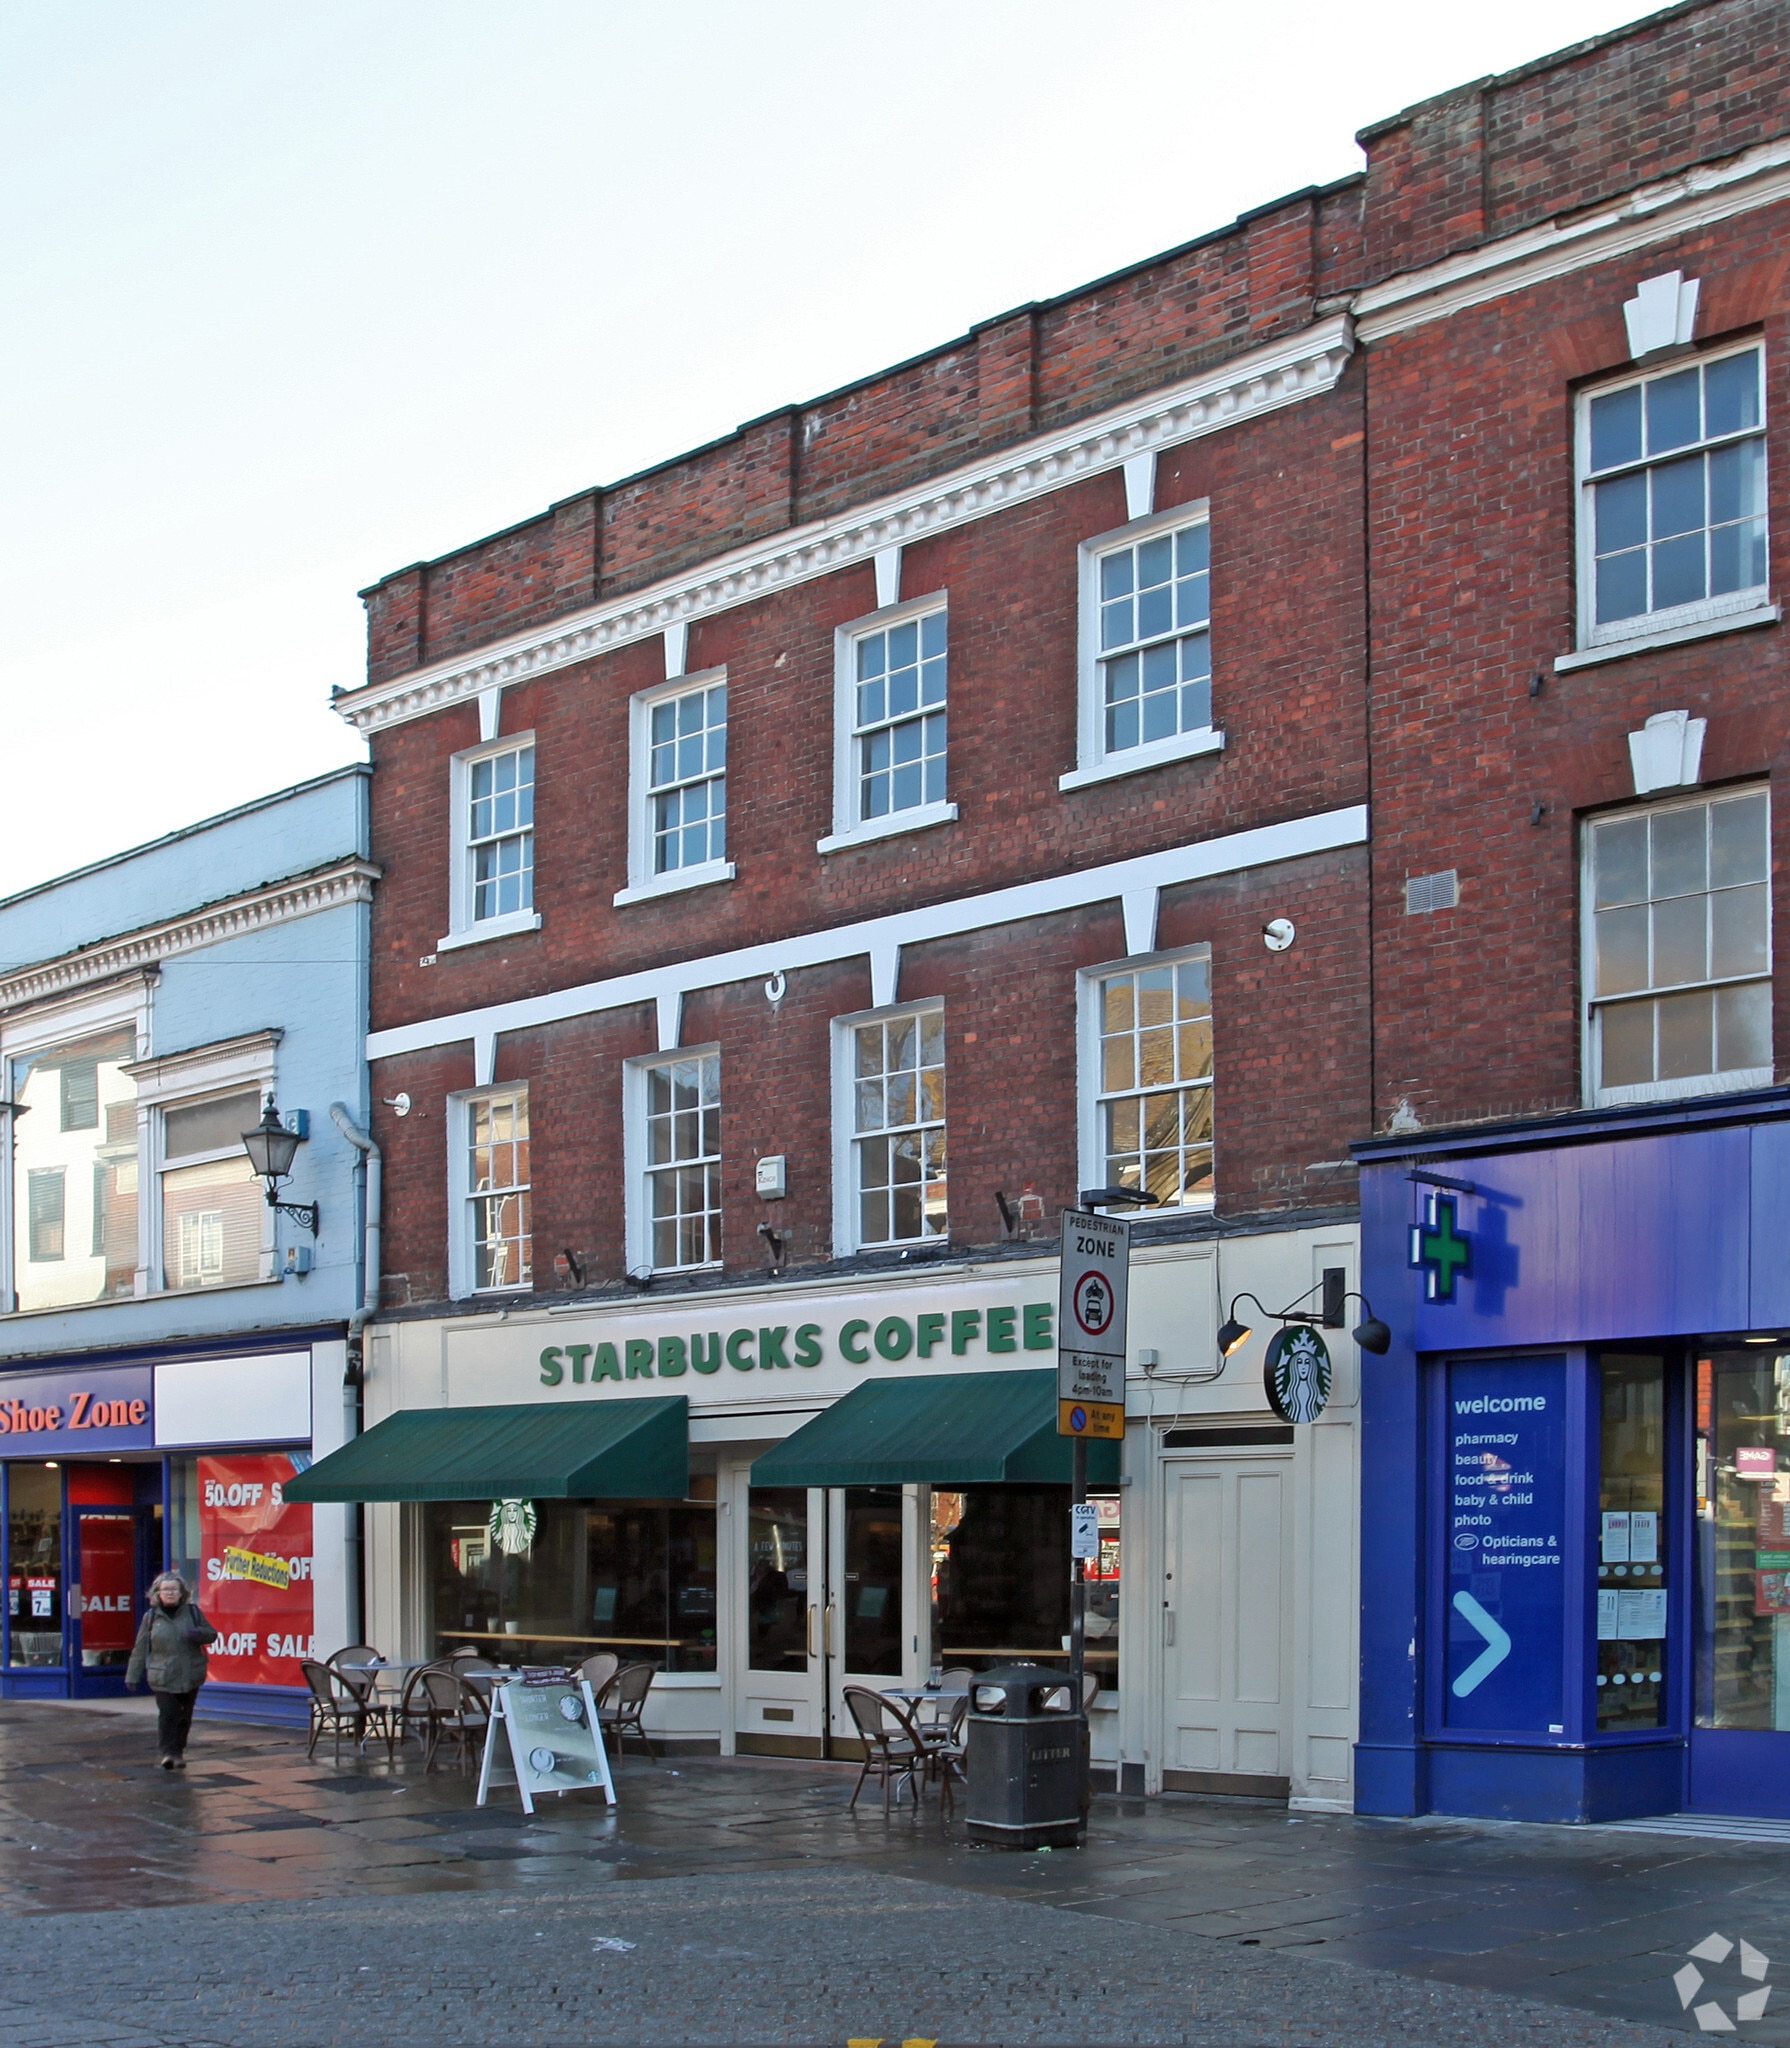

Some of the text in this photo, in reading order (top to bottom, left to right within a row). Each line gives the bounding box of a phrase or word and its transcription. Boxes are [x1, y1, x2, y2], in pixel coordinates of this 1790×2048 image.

[1070, 1216, 1124, 1235] PEDESTRIAN
[1077, 1236, 1115, 1258] ZONE
[540, 1303, 1053, 1386] STARBUCKS COFFEE
[1072, 1356, 1113, 1369] Except for
[1079, 1370, 1107, 1384] loading
[1072, 1384, 1113, 1397] 4pm-10am
[1455, 1395, 1546, 1414] welcome
[0, 1391, 147, 1434] Shoe Zone
[1091, 1408, 1115, 1423] At any
[1093, 1422, 1111, 1433] time
[1455, 1433, 1519, 1447] pharmacy
[1455, 1454, 1498, 1466] beauty
[1455, 1472, 1534, 1485] food & drink
[228, 1483, 263, 1506] OFF
[1455, 1493, 1533, 1507] baby & child
[1455, 1514, 1492, 1527] photo
[1482, 1535, 1544, 1549] Opticians
[1547, 1535, 1558, 1546] &
[1482, 1553, 1560, 1567] hearingcare
[226, 1549, 250, 1573] Further
[252, 1556, 288, 1586] Reductions
[28, 1579, 55, 1587] SALE
[82, 1596, 130, 1612] SALE
[228, 1632, 257, 1655] OFF
